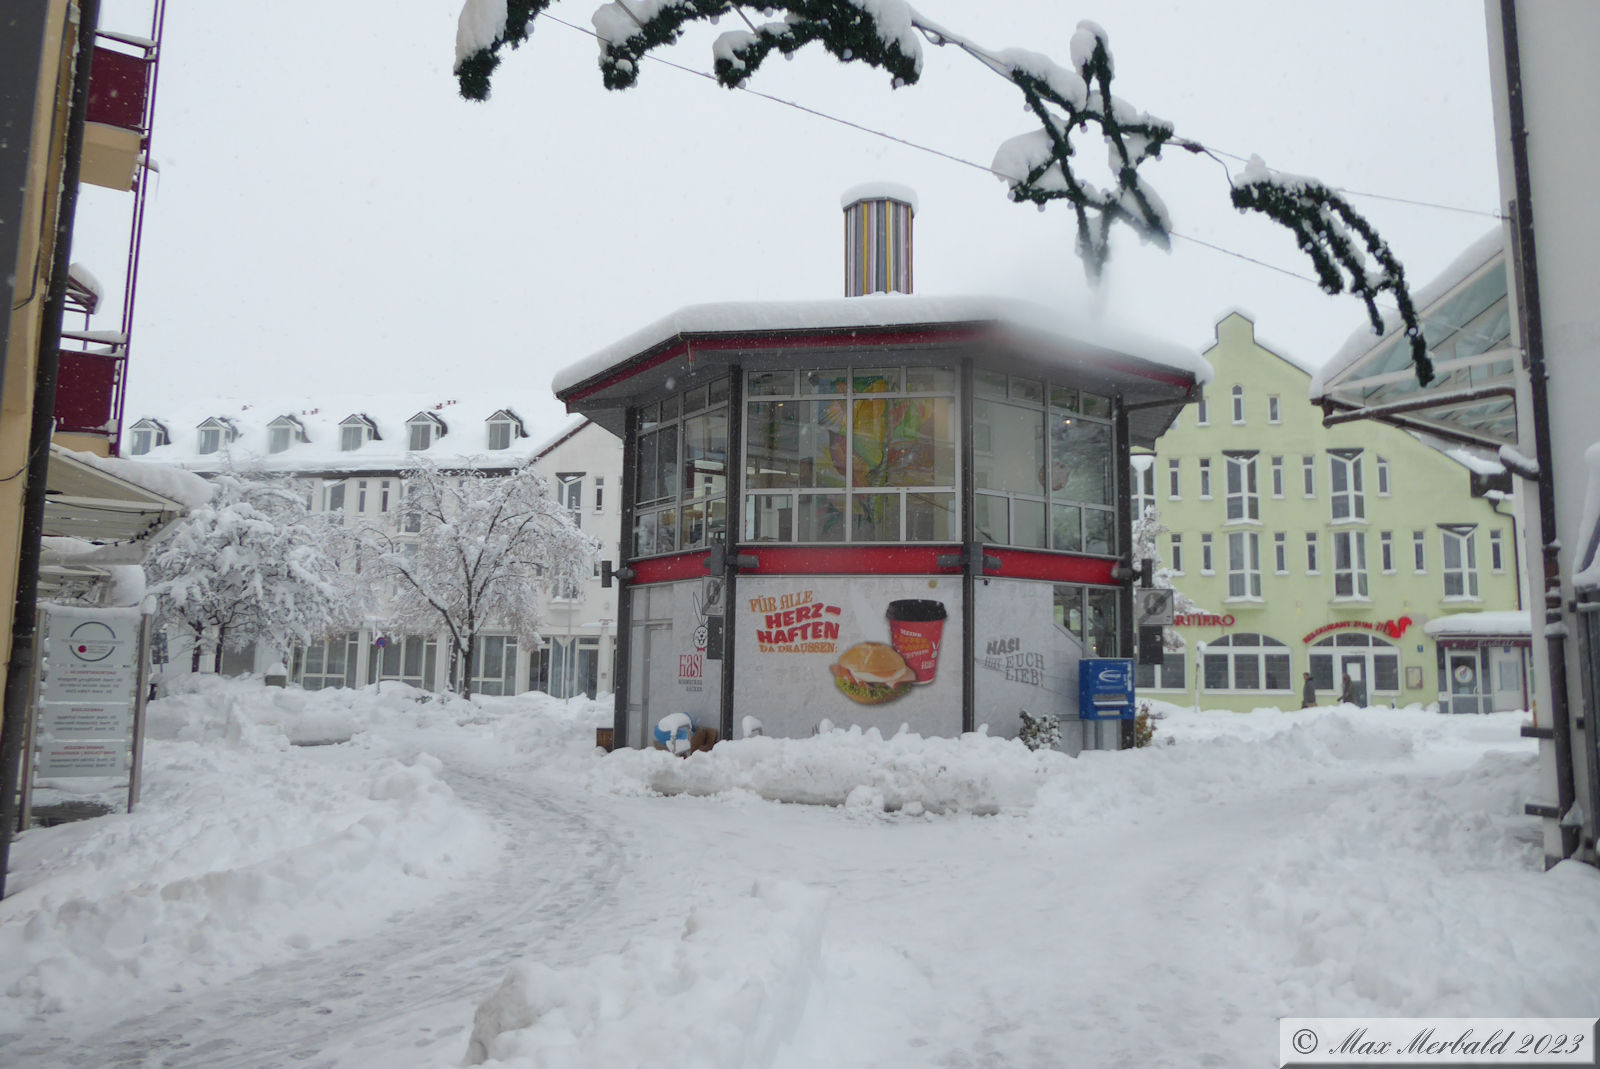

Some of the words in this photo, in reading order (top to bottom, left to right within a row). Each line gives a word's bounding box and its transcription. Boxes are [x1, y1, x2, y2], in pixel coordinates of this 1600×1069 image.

[749, 595, 777, 613] FÜR
[780, 591, 813, 610] ALLE
[765, 602, 841, 630] HERZ-
[756, 621, 840, 645] HAFTEN
[758, 644, 775, 653] DA
[777, 641, 838, 654] DRAUSSEN:
[986, 637, 1020, 656] HASI
[1006, 651, 1045, 671] EUCH
[1006, 668, 1043, 688] LIEB!
